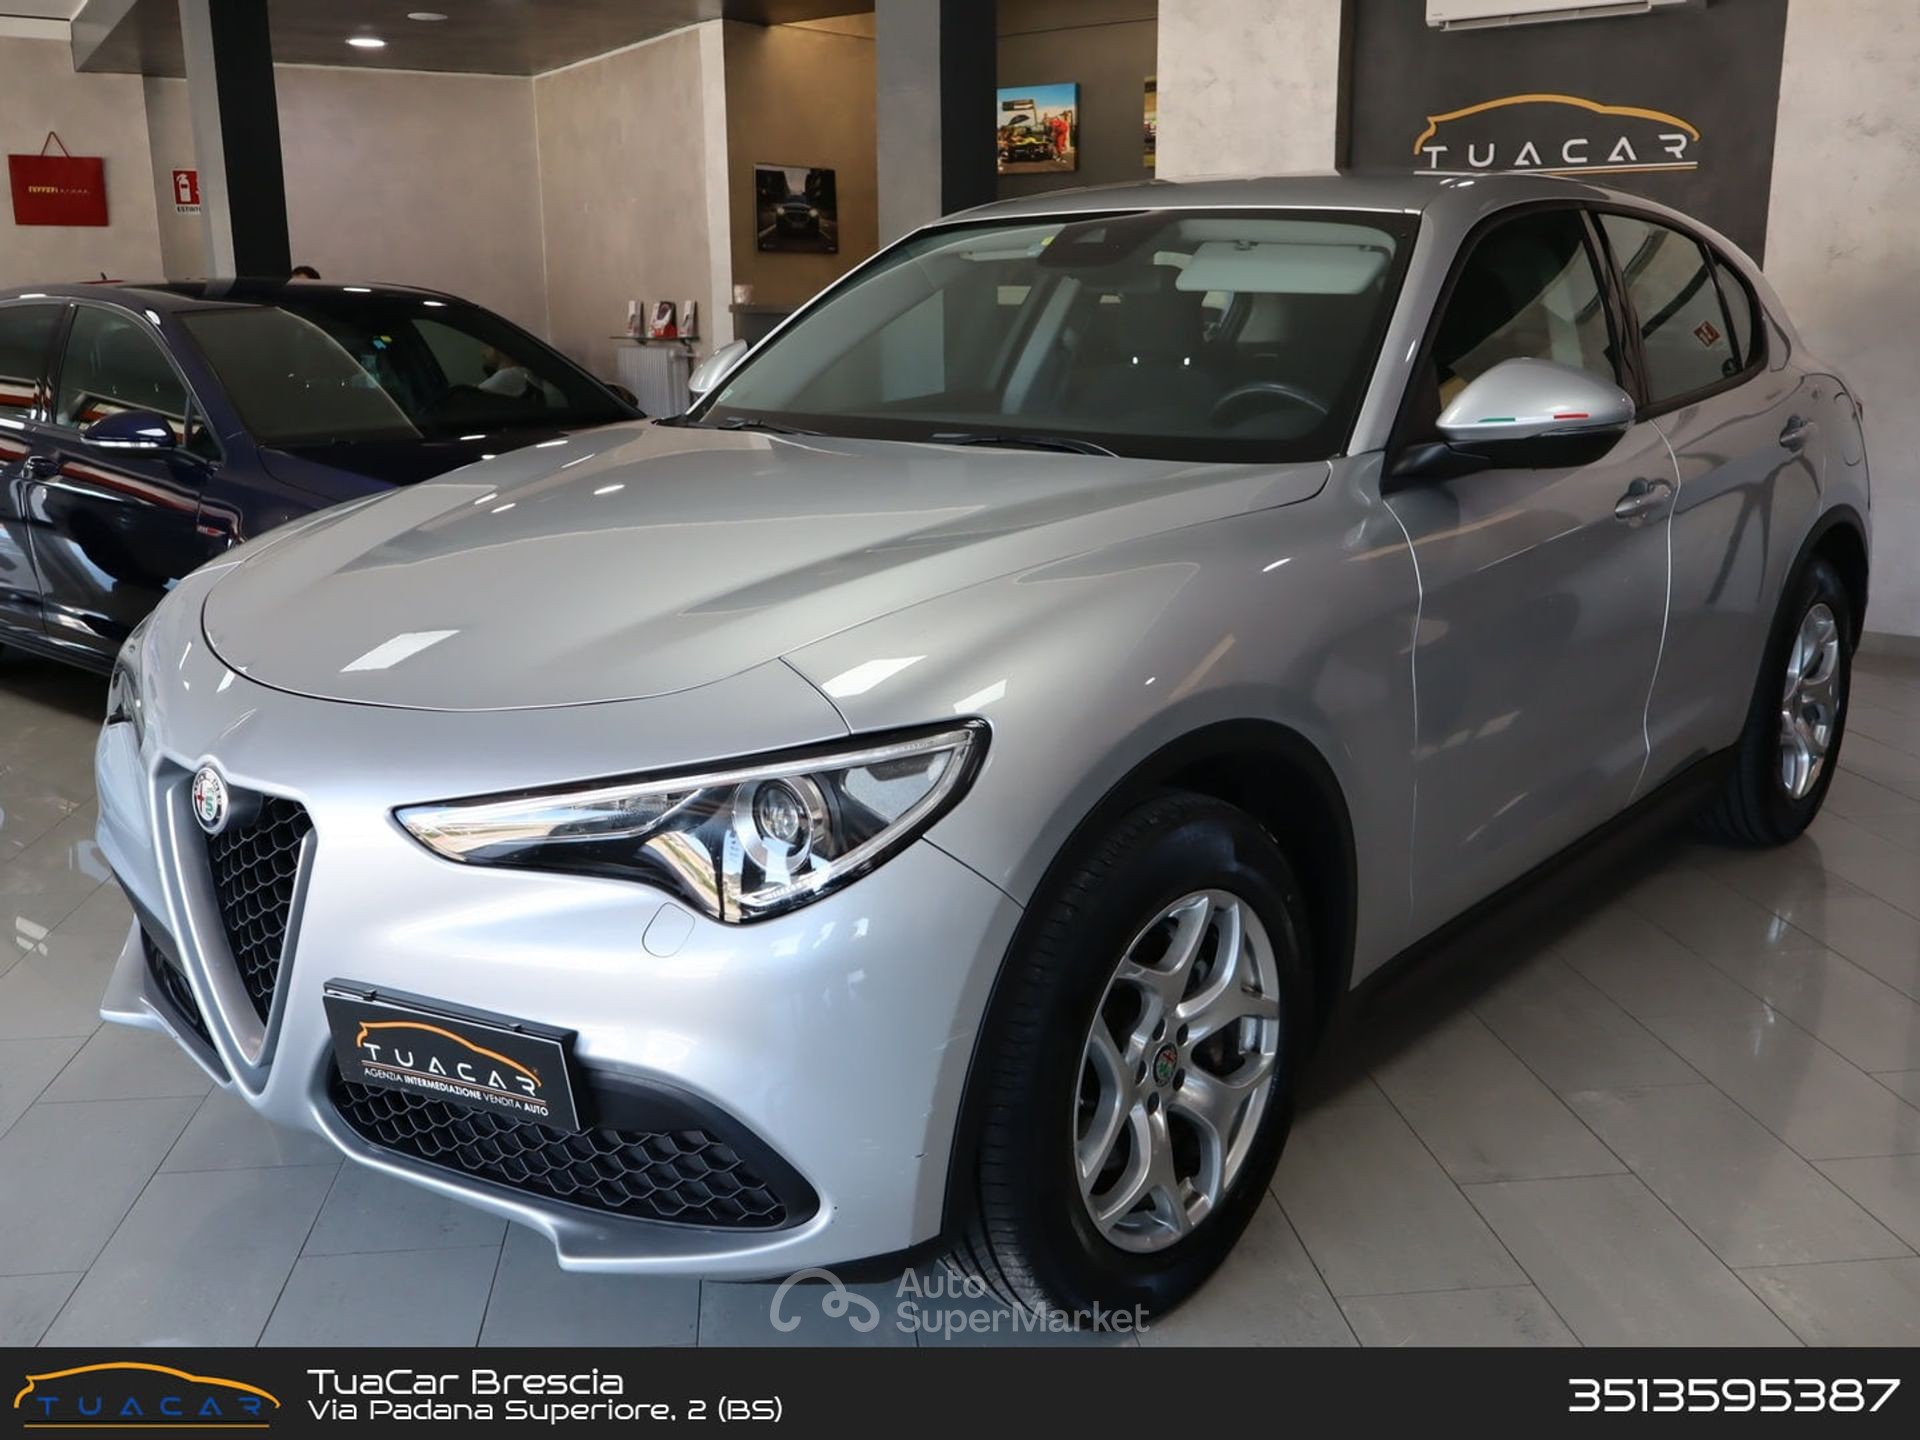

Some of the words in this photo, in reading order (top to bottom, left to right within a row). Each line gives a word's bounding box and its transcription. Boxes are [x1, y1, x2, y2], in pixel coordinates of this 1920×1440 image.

[1422, 134, 1688, 169] TUACAR
[363, 1042, 536, 1097] TUACAR
[364, 1067, 403, 1082] AGENZIA
[403, 1075, 482, 1100] INTERMEDIAZIONE
[482, 1093, 522, 1109] VENDITA
[523, 1102, 549, 1117] AUTO
